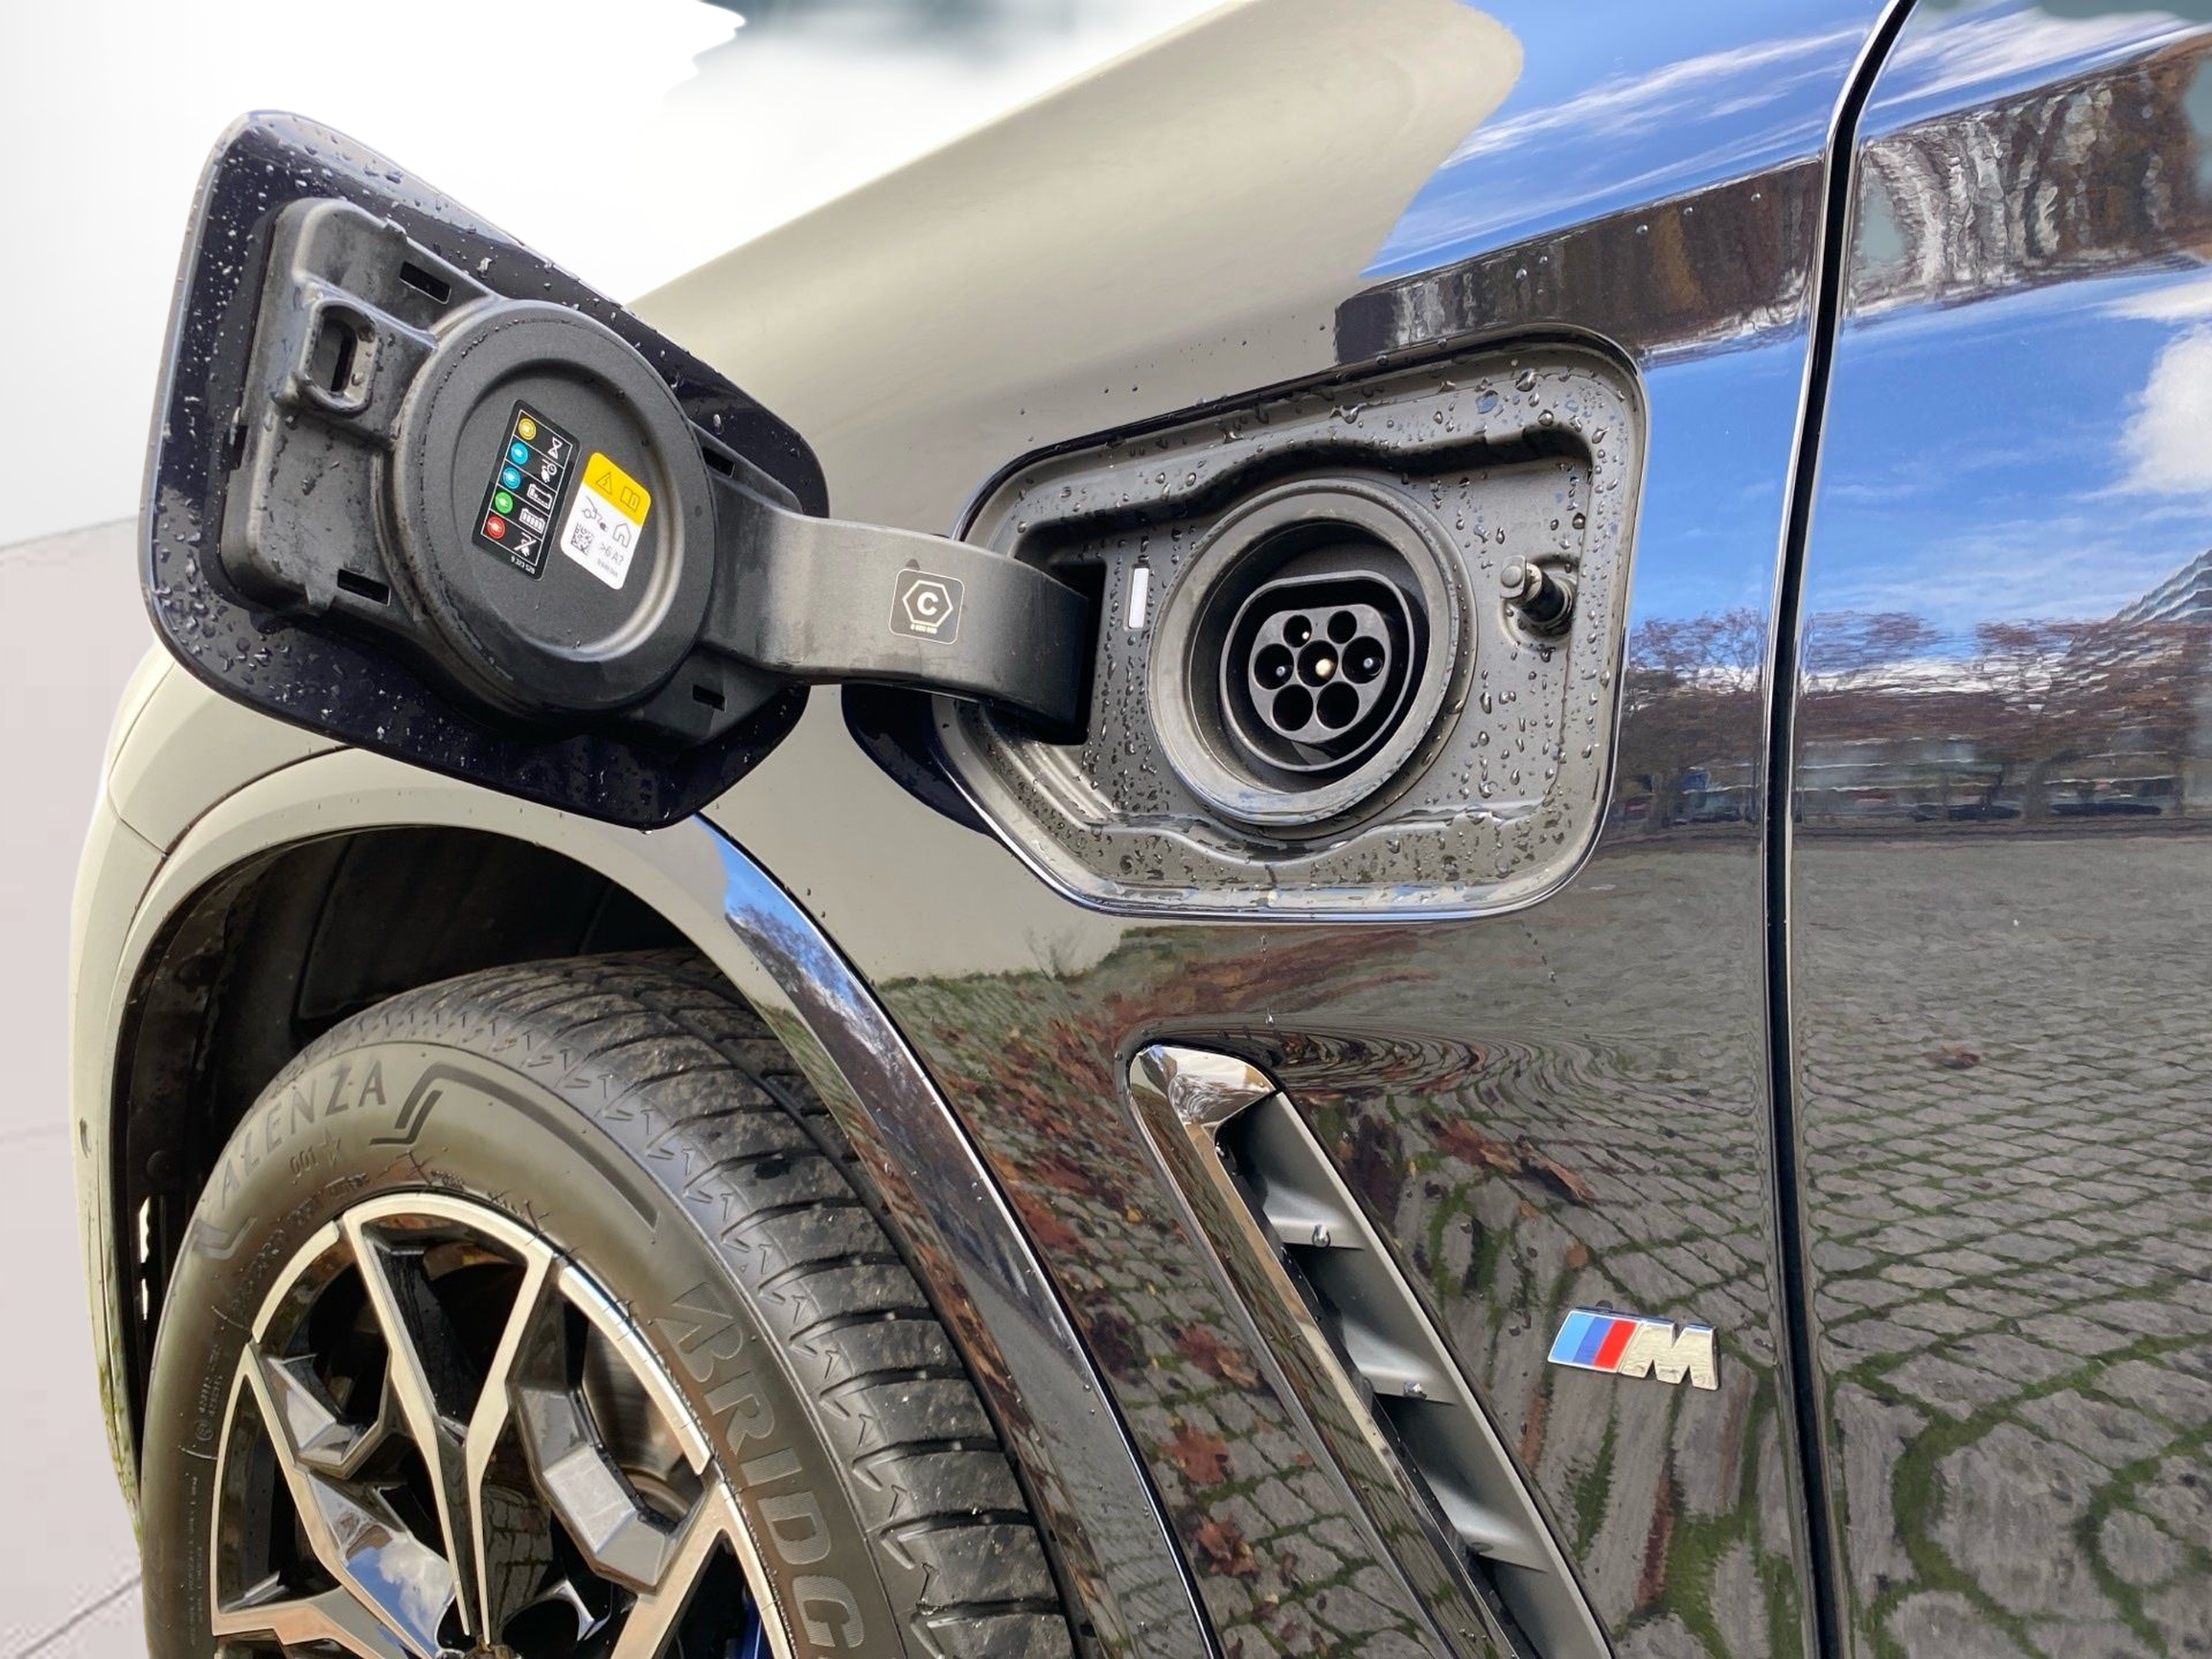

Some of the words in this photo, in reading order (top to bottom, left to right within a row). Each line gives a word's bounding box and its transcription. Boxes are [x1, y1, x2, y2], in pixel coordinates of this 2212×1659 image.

[917, 591, 939, 616] C
[222, 1061, 386, 1209] ALENZA
[1618, 1320, 1719, 1391] M
[655, 1281, 865, 1659] BRIDG
